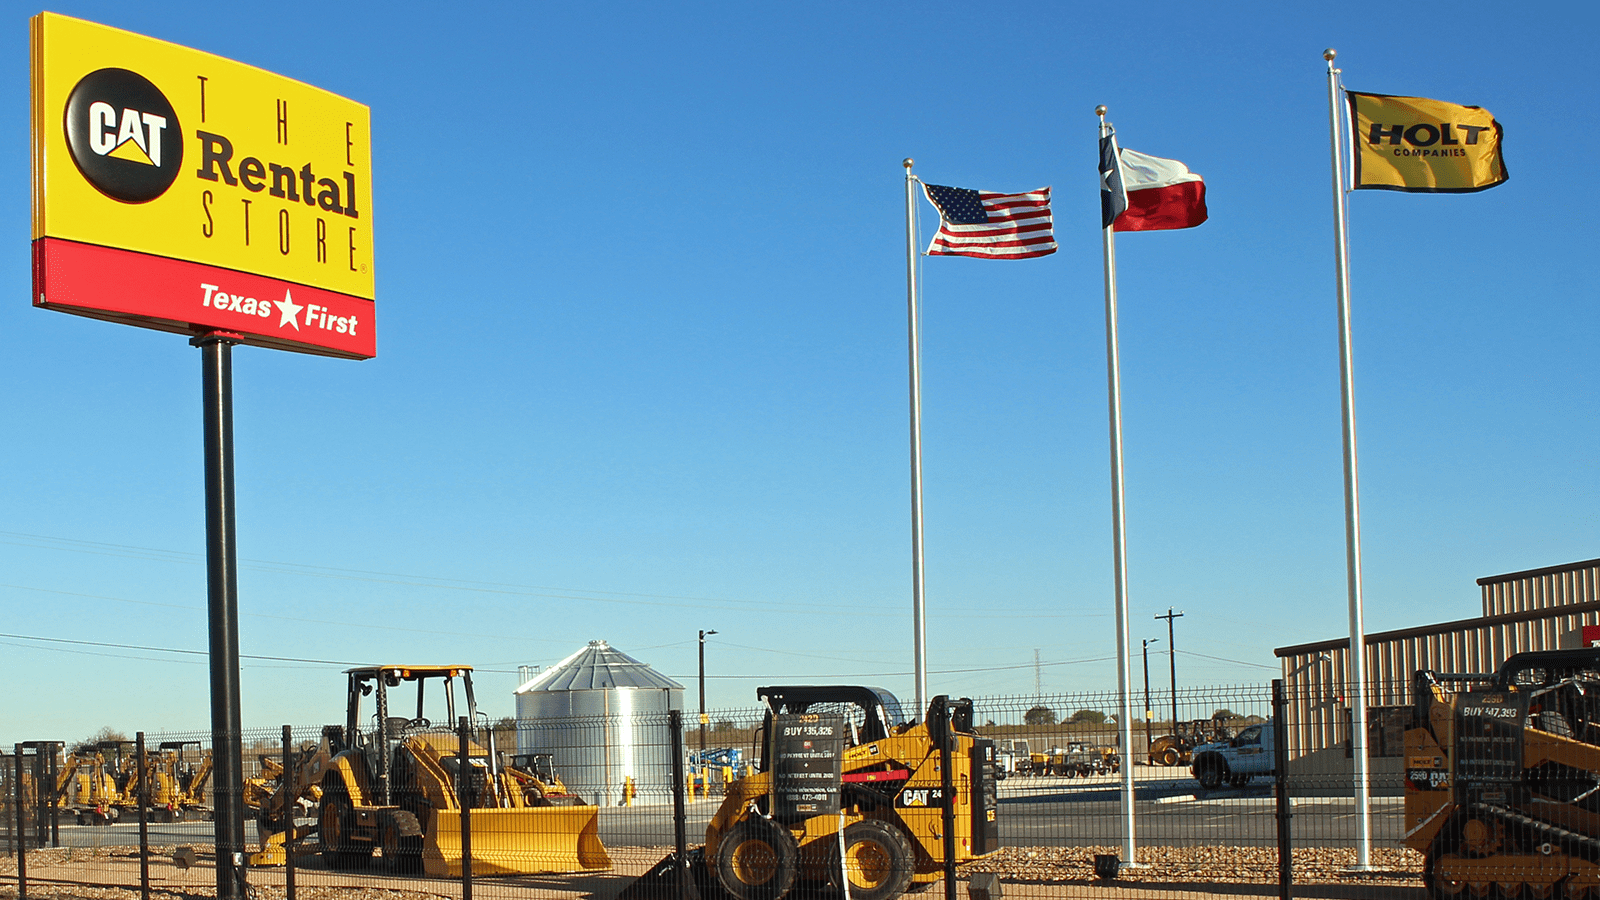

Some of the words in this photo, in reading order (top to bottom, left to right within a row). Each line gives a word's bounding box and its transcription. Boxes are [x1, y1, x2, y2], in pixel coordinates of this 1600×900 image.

[89, 101, 167, 168] CAT
[1369, 122, 1490, 147] HOLT
[1393, 148, 1466, 157] COMPANIES
[196, 129, 359, 219] Rental
[202, 189, 357, 272] STORE
[200, 283, 272, 318] Texas
[305, 303, 358, 336] First
[1464, 706, 1484, 717] BUY
[783, 726, 803, 736] BUY
[803, 726, 833, 736] $35,826
[903, 789, 929, 806] CAT
